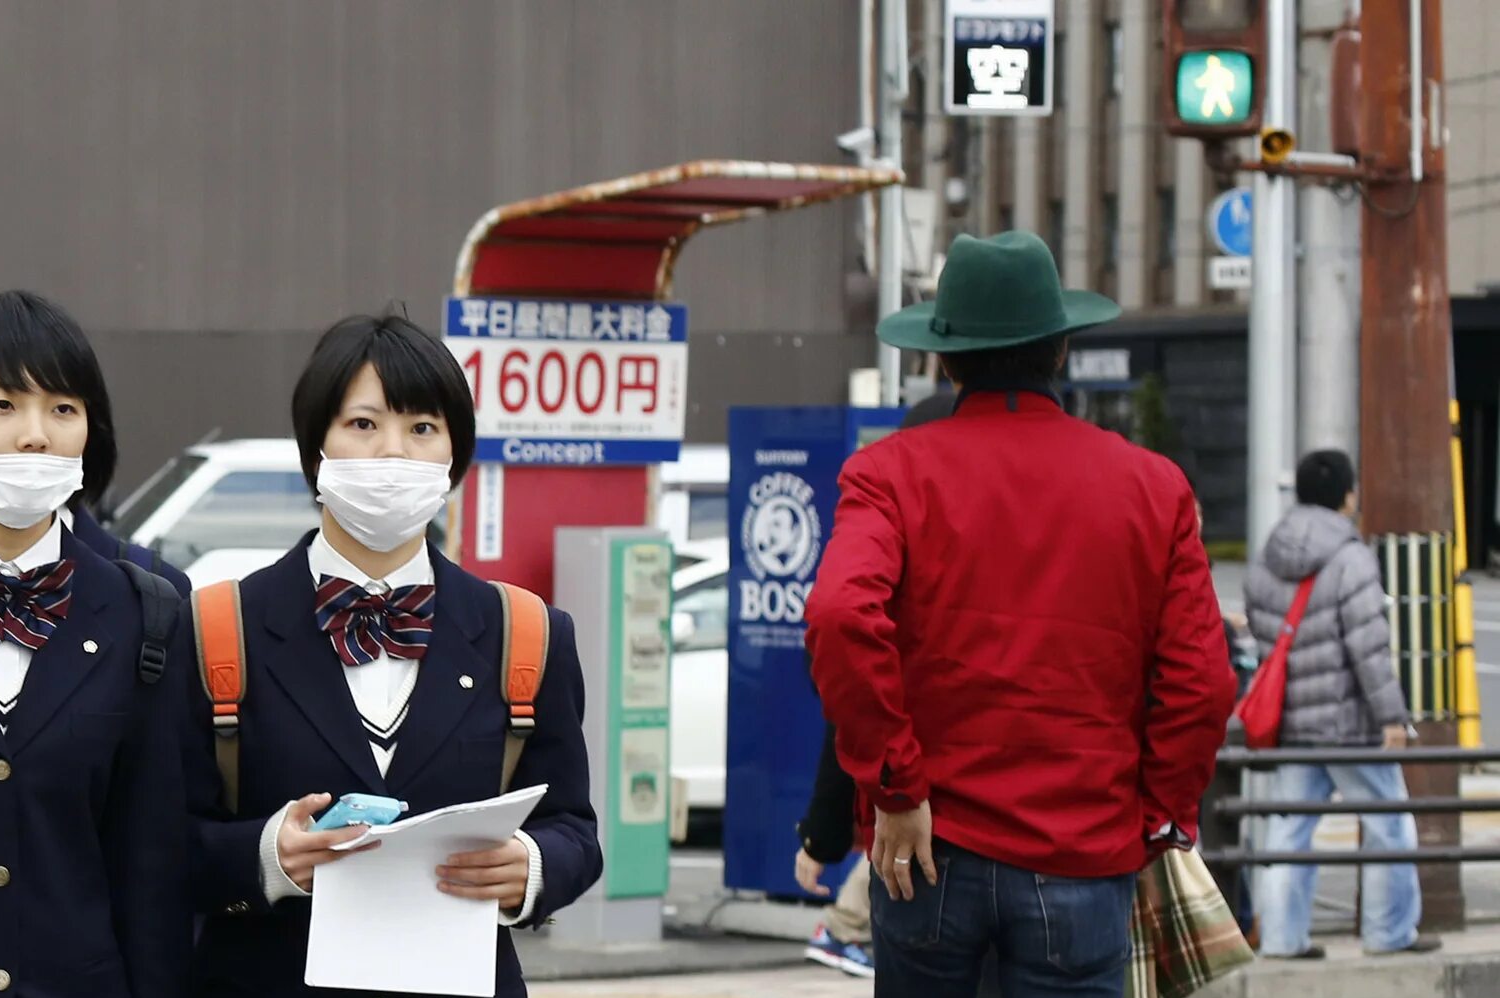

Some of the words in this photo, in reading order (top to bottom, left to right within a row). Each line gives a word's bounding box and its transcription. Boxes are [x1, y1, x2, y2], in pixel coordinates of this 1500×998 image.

[967, 44, 1029, 109] 空
[463, 348, 660, 416] 1600円
[502, 437, 606, 465] Concept
